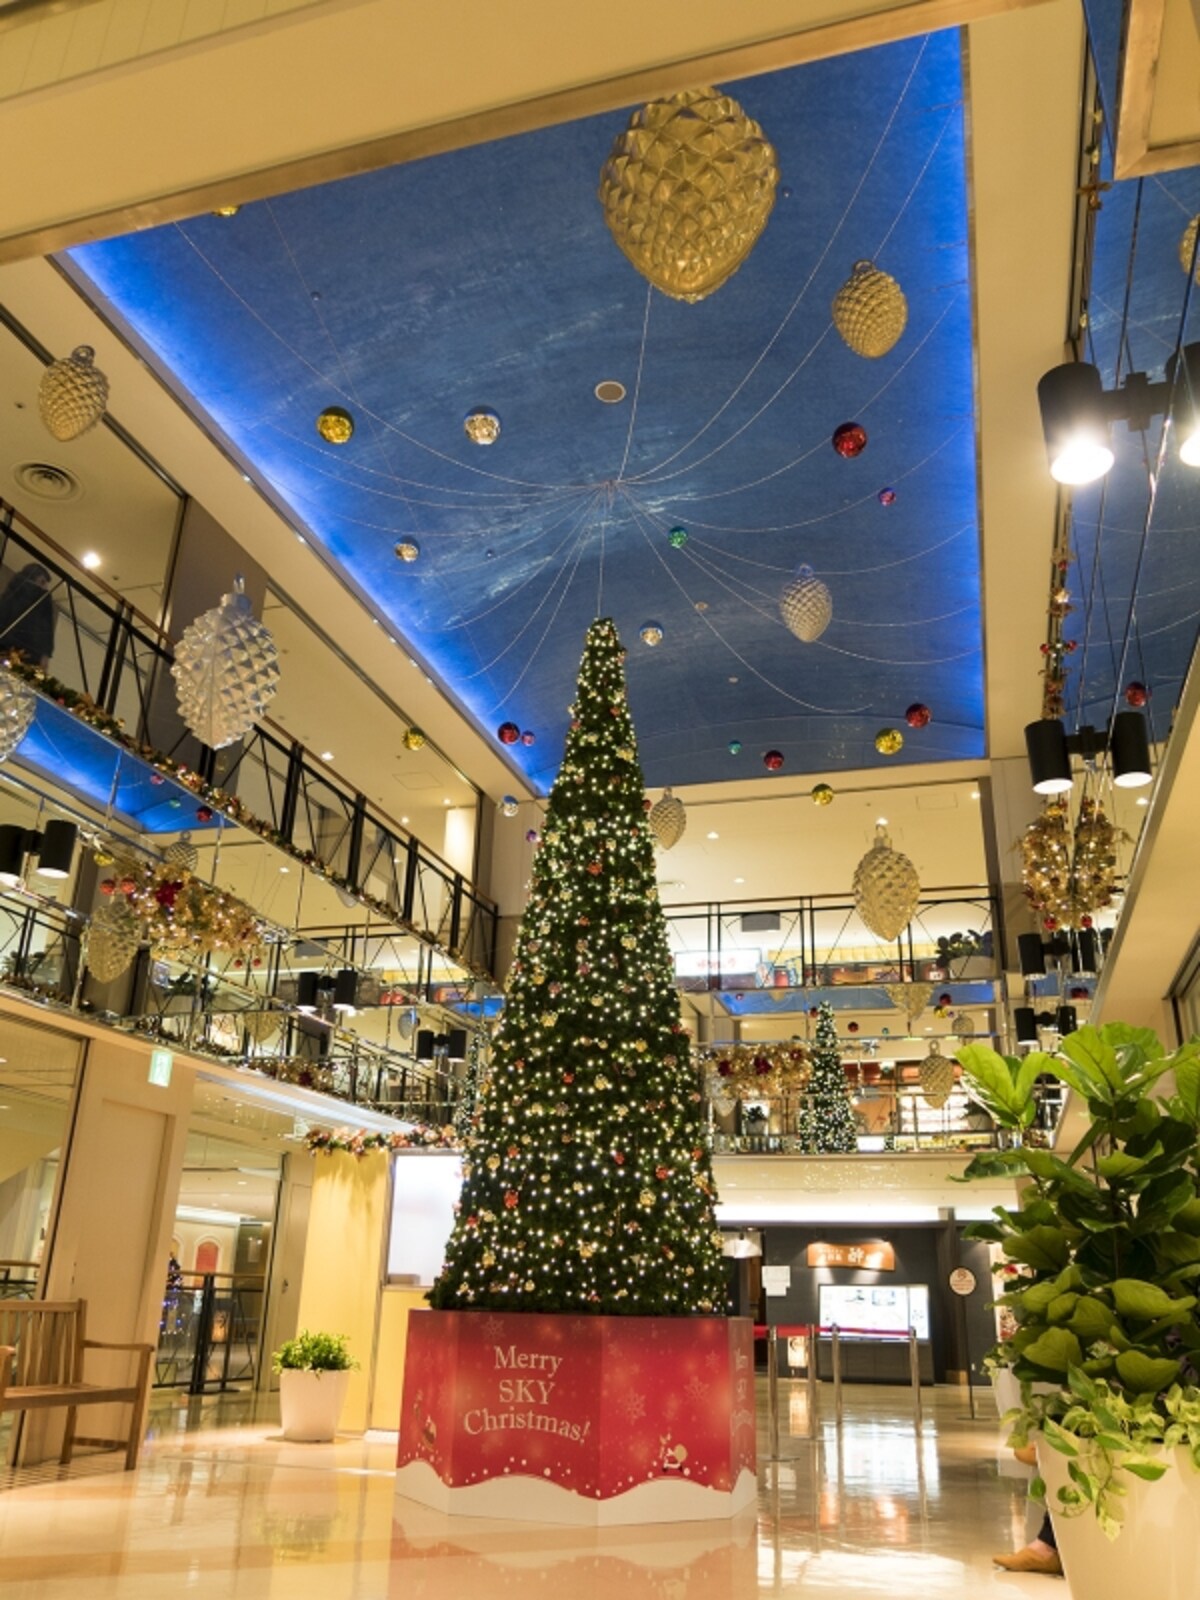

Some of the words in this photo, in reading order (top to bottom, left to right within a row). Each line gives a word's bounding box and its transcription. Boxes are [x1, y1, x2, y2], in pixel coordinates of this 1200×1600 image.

[494, 1345, 563, 1378] Merry
[499, 1379, 555, 1405] SKY
[464, 1406, 591, 1444] Christmas!
